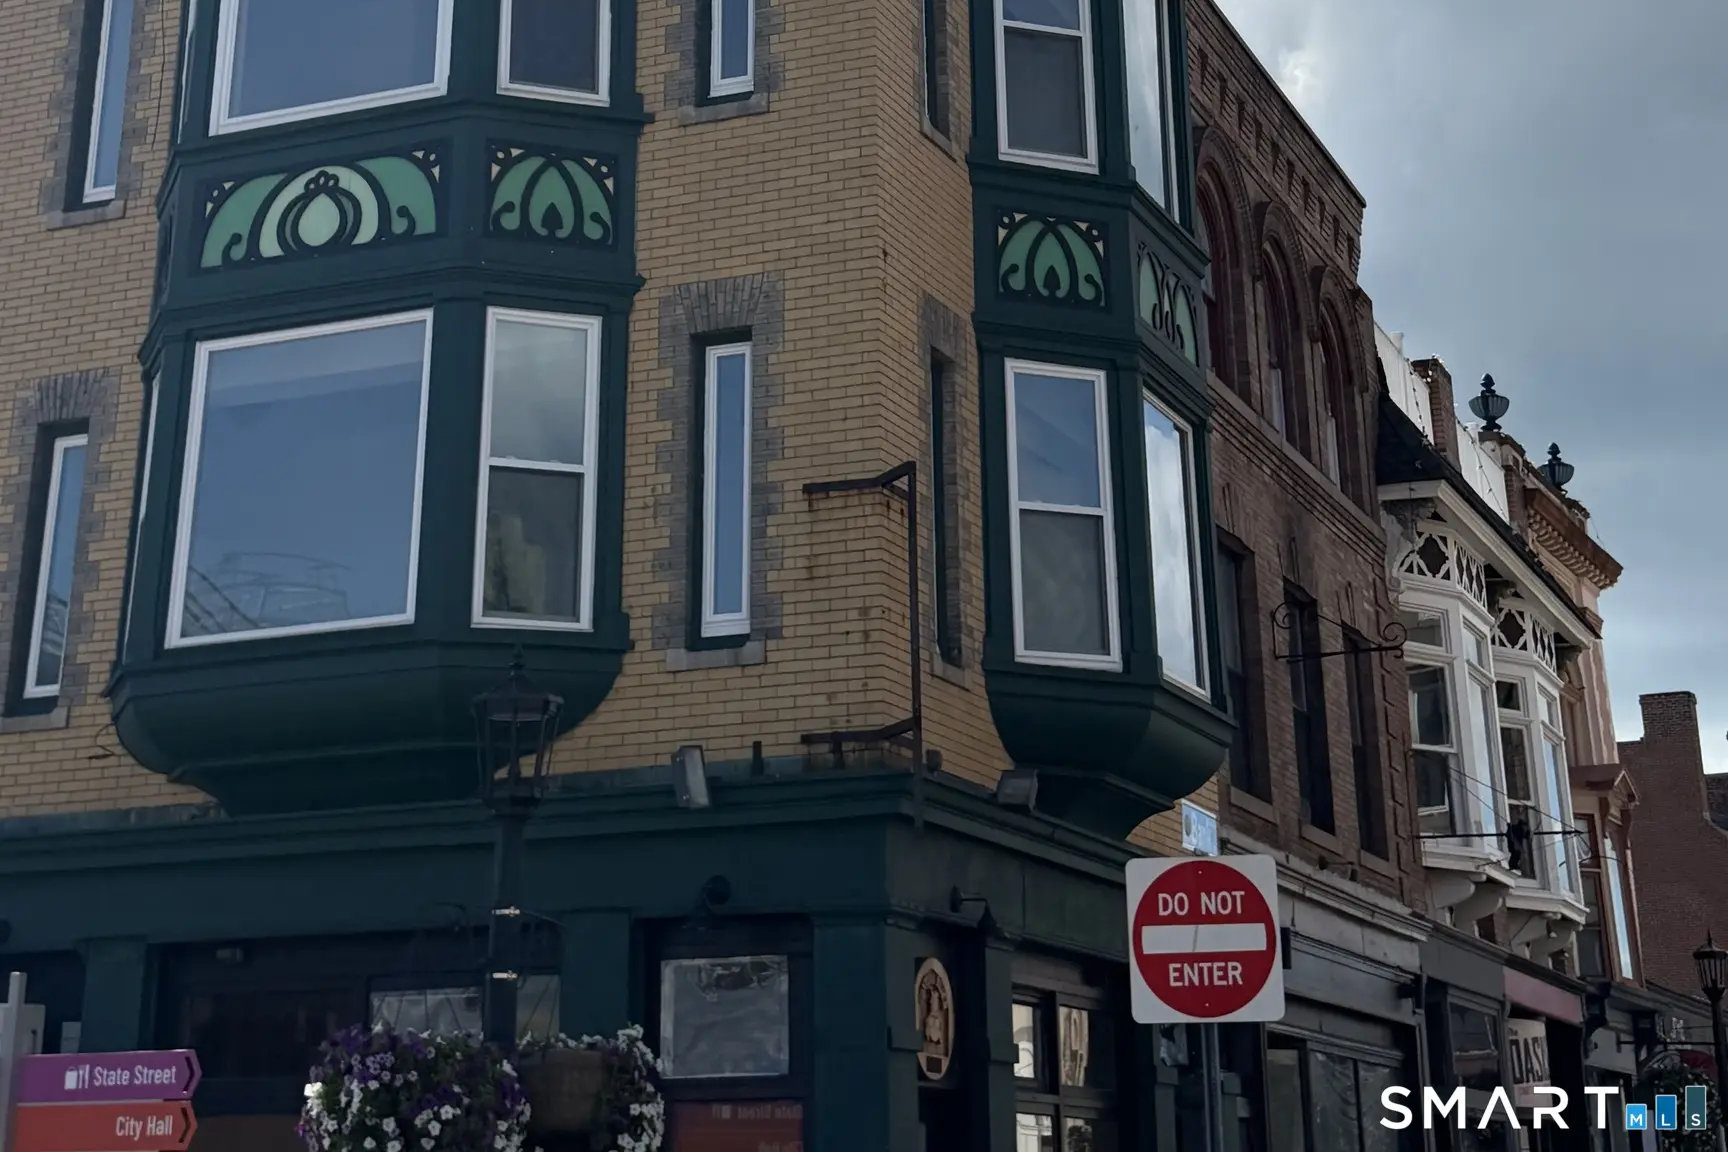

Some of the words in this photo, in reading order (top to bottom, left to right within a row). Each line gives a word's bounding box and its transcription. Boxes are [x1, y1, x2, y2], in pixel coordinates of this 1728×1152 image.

[1158, 892, 1189, 916] DO
[1200, 891, 1245, 915] NOT
[1168, 961, 1243, 987] ENTER
[93, 1065, 130, 1086] State
[133, 1064, 177, 1085] Street
[115, 1116, 143, 1141] City
[146, 1115, 173, 1136] Hall
